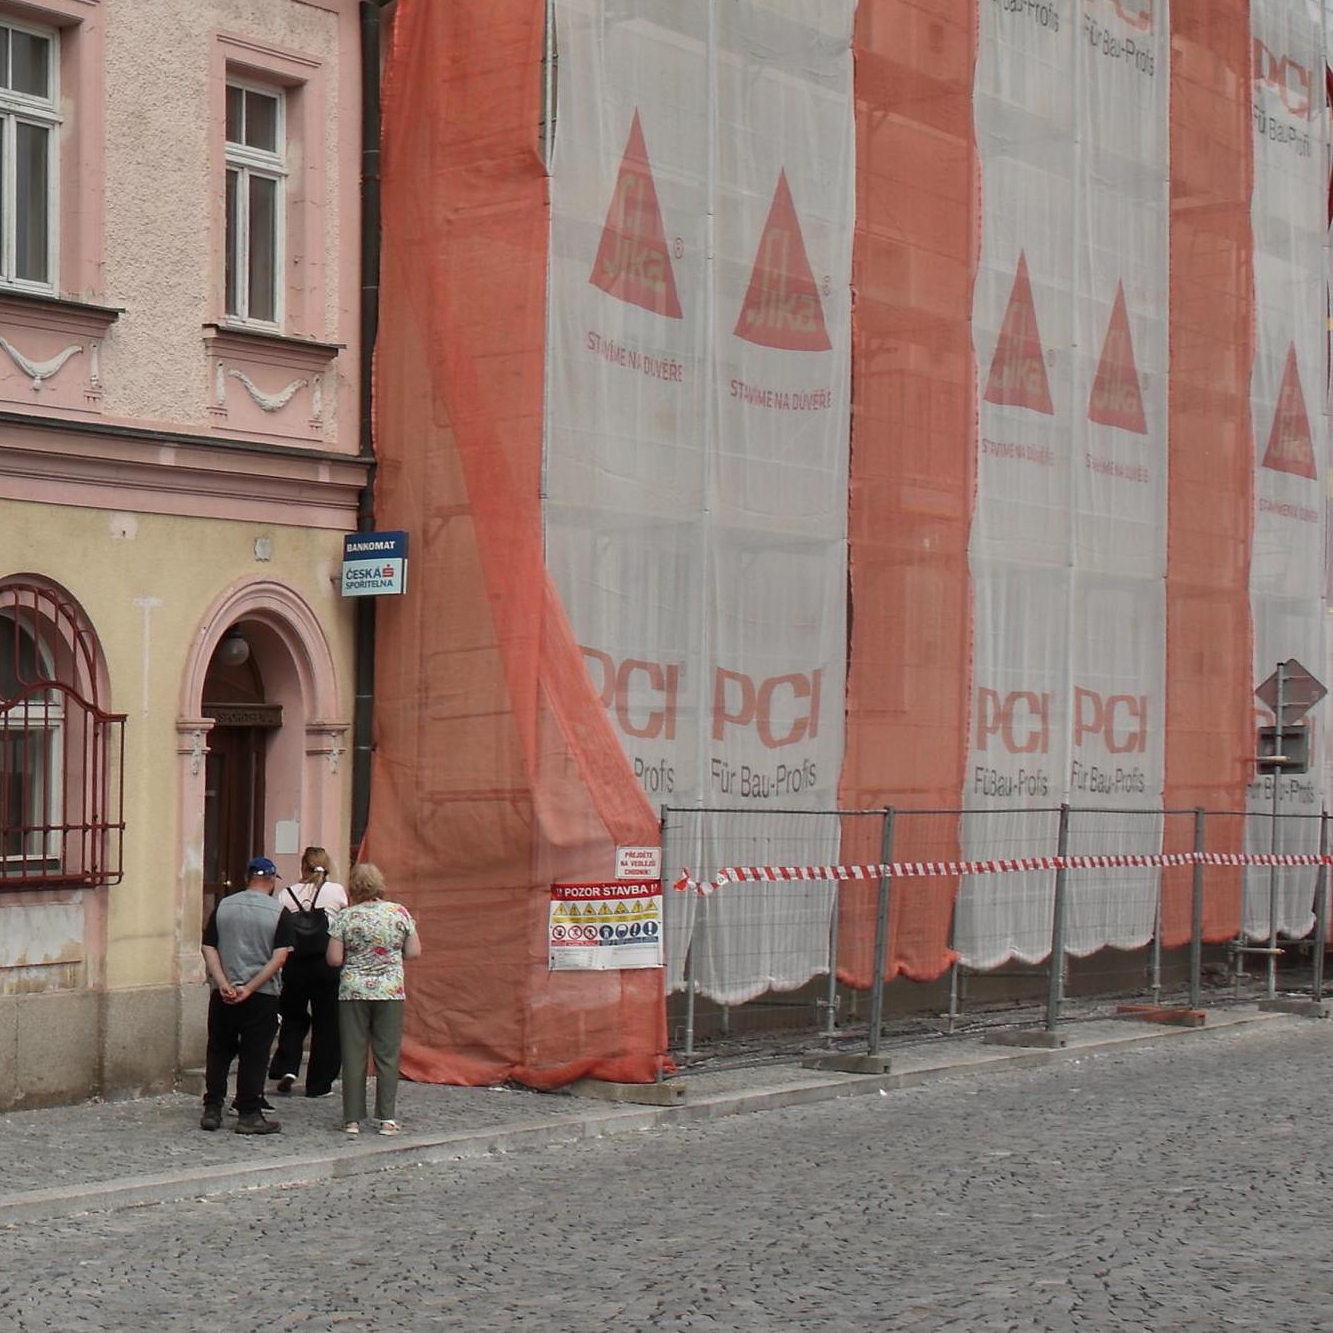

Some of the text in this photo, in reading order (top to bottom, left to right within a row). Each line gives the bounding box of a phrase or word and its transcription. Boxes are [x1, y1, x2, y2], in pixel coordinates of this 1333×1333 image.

[346, 541, 396, 552] BANKOMAT
[345, 579, 394, 589] SPOŘITELNA
[346, 567, 382, 580] ČESKÁ
[712, 667, 822, 748] PCI
[977, 686, 1049, 754] PCI
[1074, 684, 1147, 753] PCI
[634, 757, 675, 793] Profis
[711, 758, 817, 798] Für Bau-Profis
[1090, 766, 1145, 795] Bau-Profis
[564, 887, 601, 897] POZOR
[602, 884, 649, 896] STAVBA
